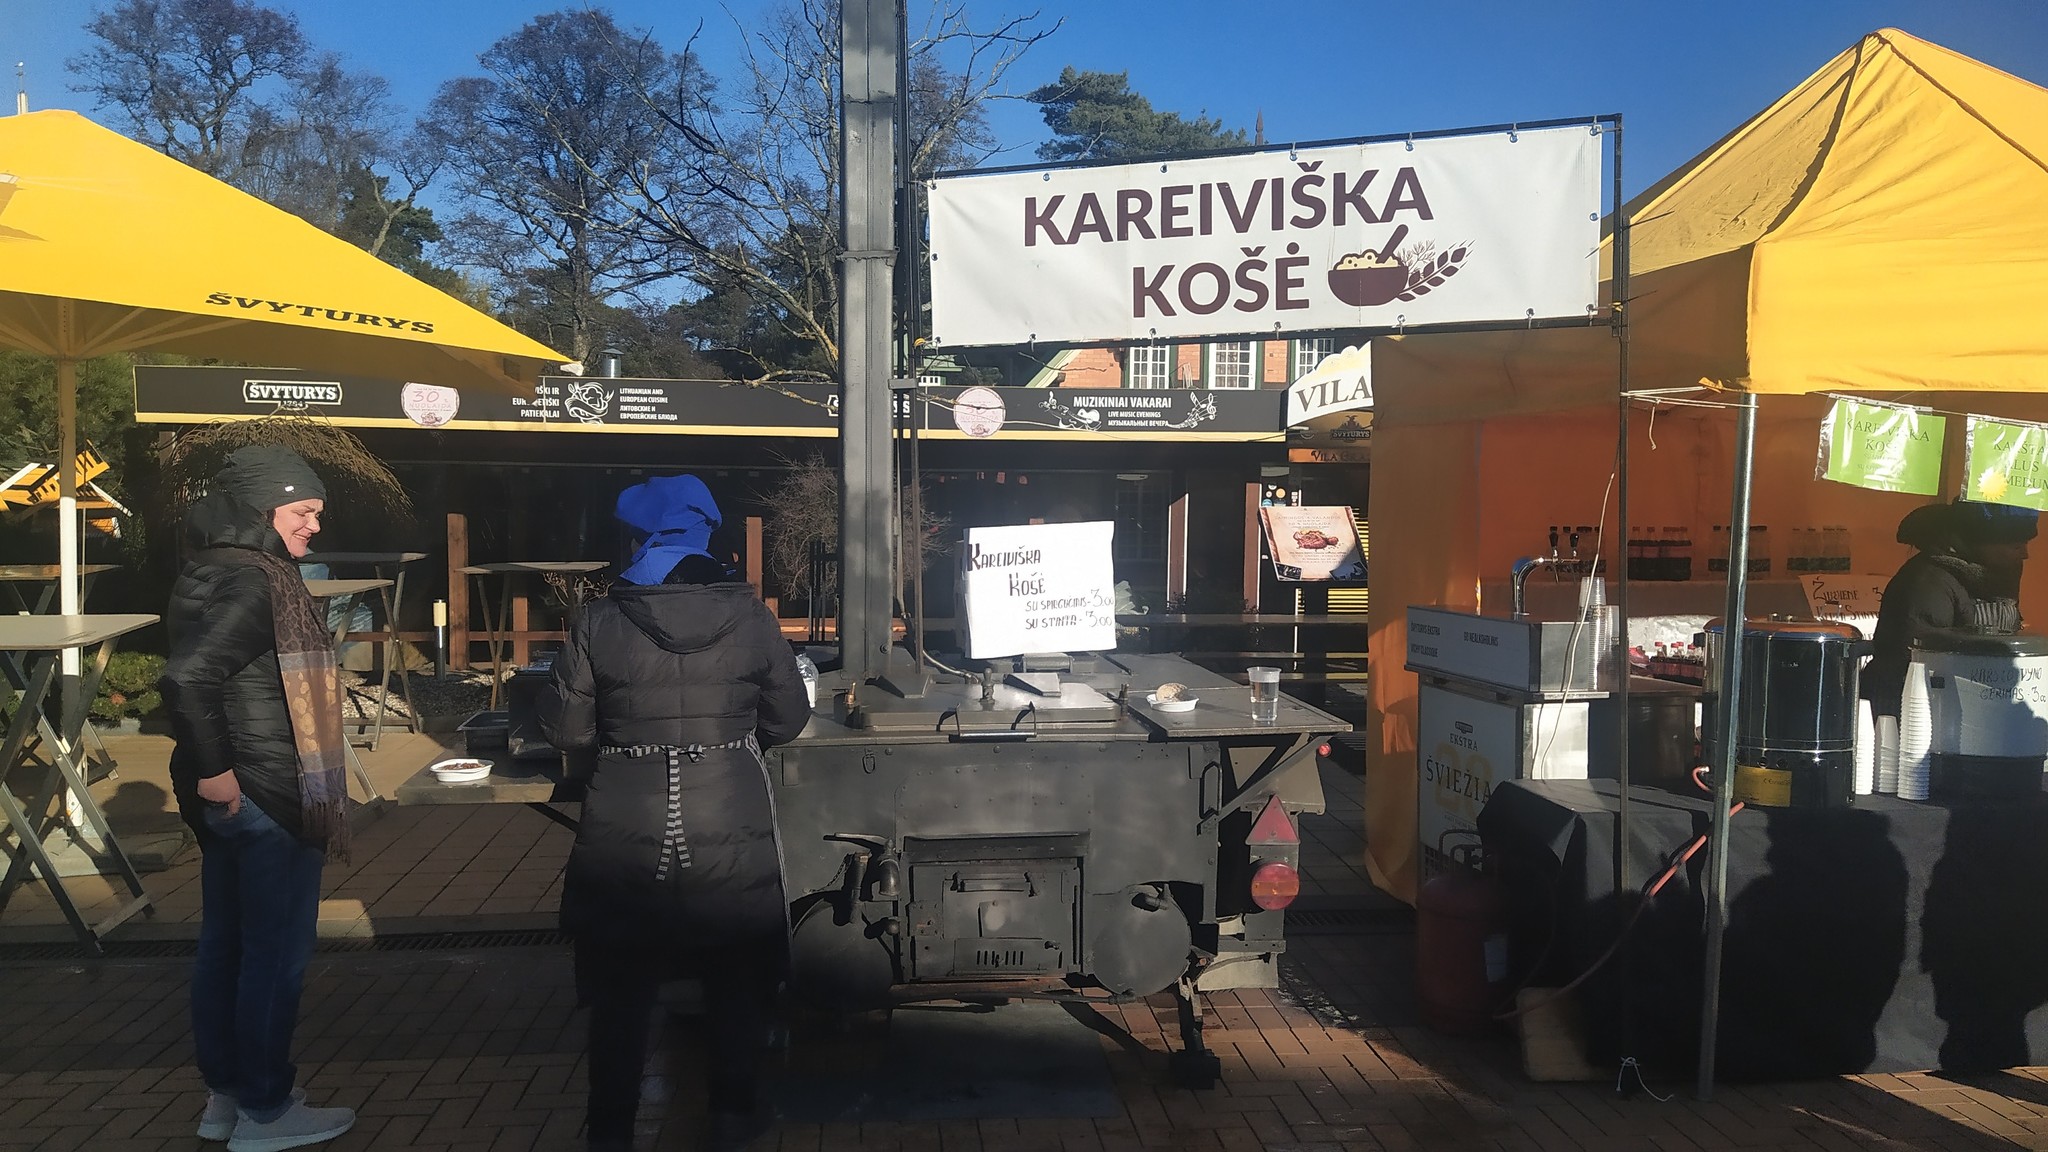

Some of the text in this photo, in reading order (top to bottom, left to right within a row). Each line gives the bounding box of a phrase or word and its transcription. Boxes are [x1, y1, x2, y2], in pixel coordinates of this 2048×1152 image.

[1024, 160, 1435, 247] KAREIVIŠKA
[1133, 242, 1310, 319] KOŠĖ
[205, 292, 434, 333] ŠVYTURYS
[249, 382, 338, 400] ŠVYTURYS
[412, 391, 439, 402] 30
[552, 387, 560, 395] IR
[1296, 375, 1373, 412] VILA
[512, 397, 560, 406] EURETIŠKI
[1073, 396, 1172, 408] MUZIKINIAI VAKARAI
[520, 409, 560, 418] PATIEKALAI
[1311, 450, 1338, 461] VILA
[2004, 459, 2039, 472] LUS
[967, 543, 1041, 571] KAREIVIŠKA
[1008, 572, 1046, 596] KOŠĖ
[1025, 600, 1038, 612] SU
[1025, 618, 1038, 630] SU
[1450, 732, 1478, 751] EKSTRA
[1426, 755, 1492, 804] ŠVIEŽIA
